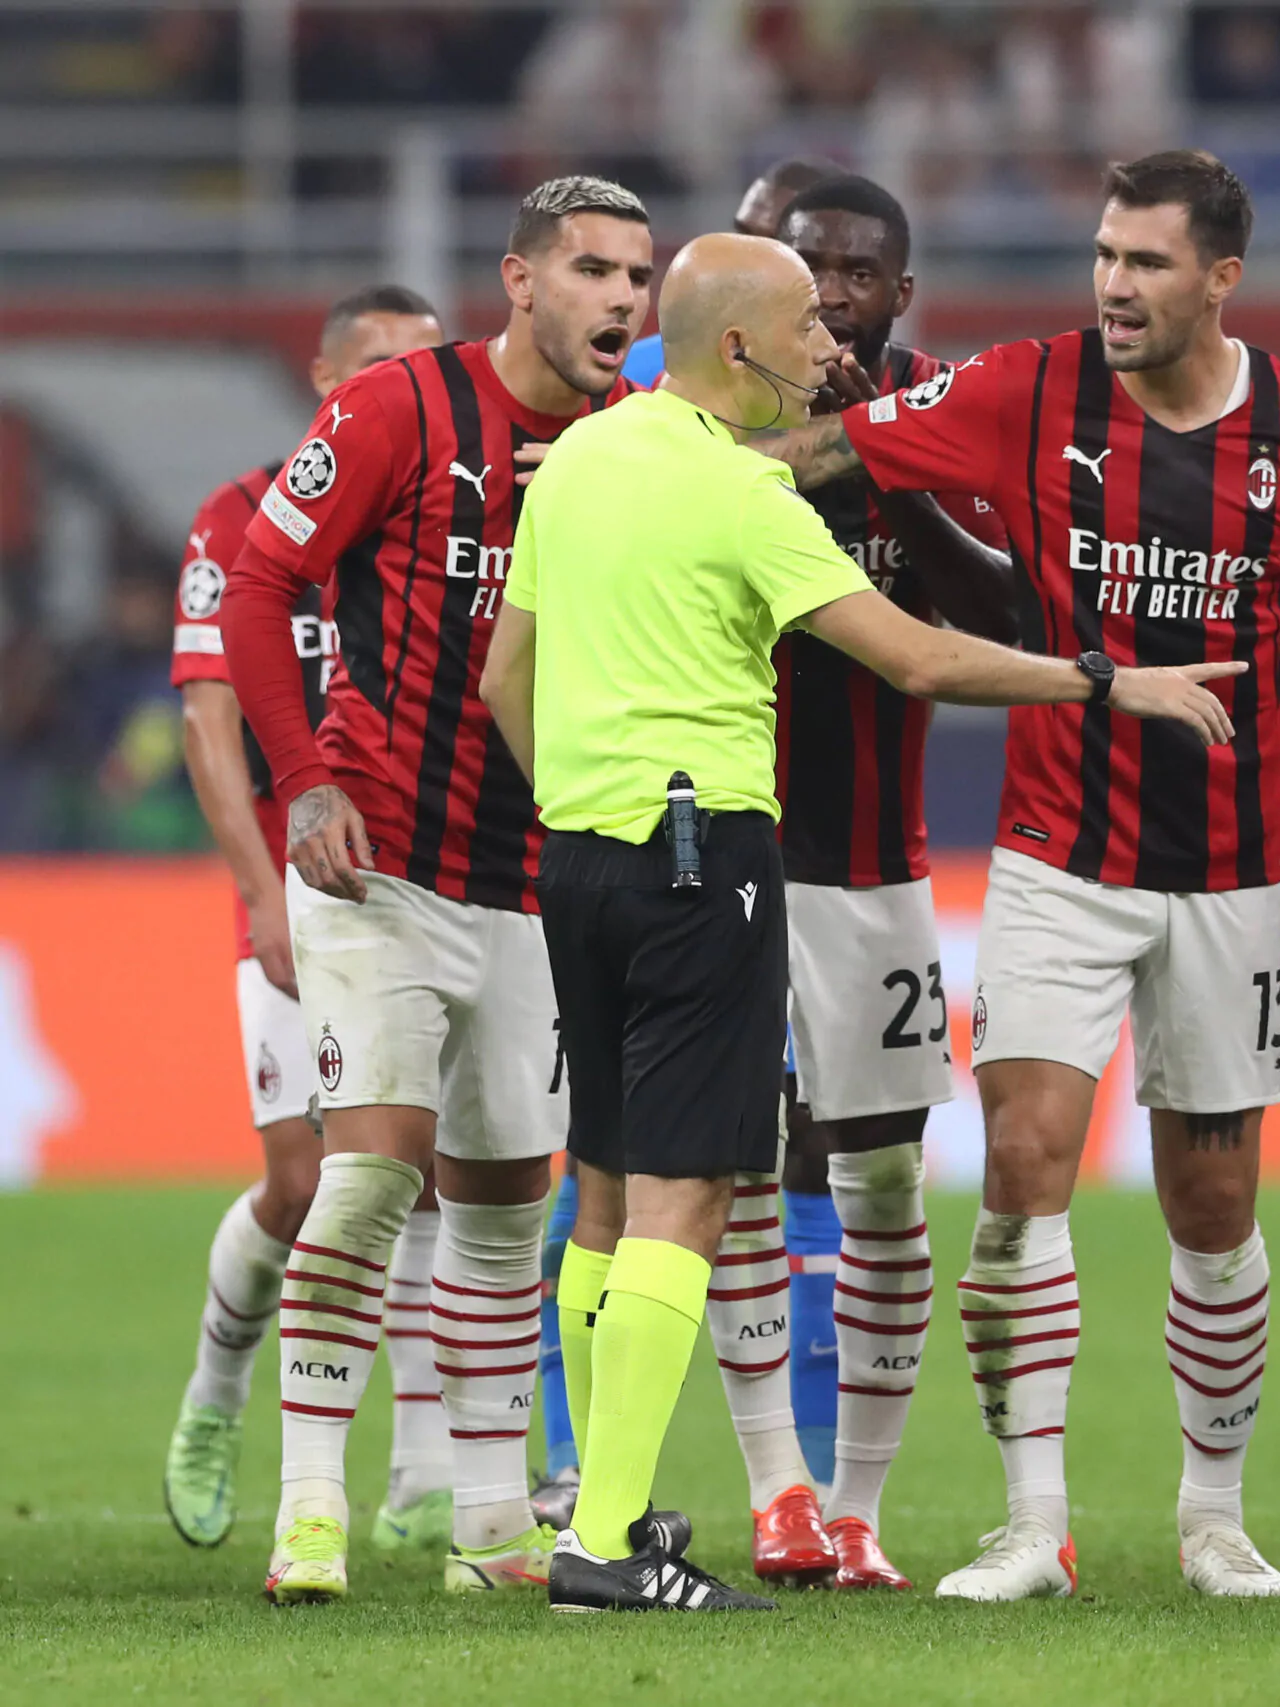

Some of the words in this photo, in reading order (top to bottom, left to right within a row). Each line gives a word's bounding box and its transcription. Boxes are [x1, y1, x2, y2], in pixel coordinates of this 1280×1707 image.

[1068, 527, 1268, 586] Emirates
[1097, 580, 1141, 615] FLY
[1147, 584, 1240, 620] BETTER
[882, 960, 947, 1049] 23
[738, 1314, 786, 1340] ACM
[289, 1360, 350, 1382] ACM
[871, 1350, 922, 1371] ACM
